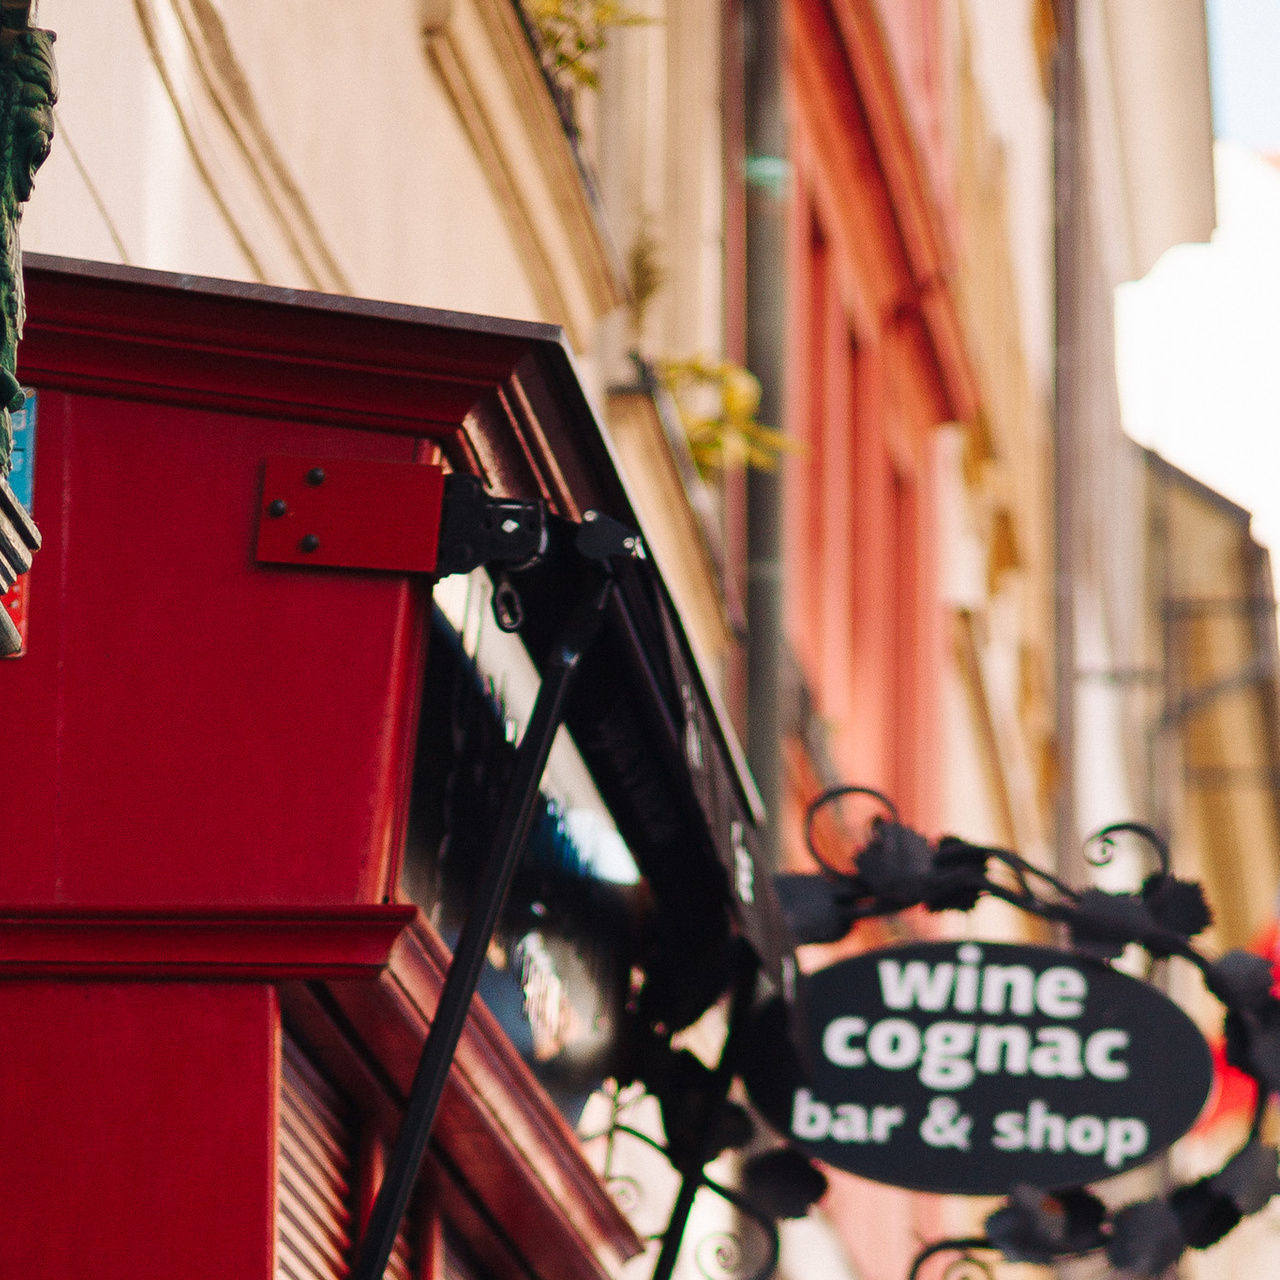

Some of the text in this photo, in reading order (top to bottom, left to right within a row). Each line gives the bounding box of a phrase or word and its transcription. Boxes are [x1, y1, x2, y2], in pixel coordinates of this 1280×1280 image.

[876, 943, 1089, 1019] wine
[822, 1015, 1131, 1091] cognac
[790, 1088, 1150, 1168] bar & shop
